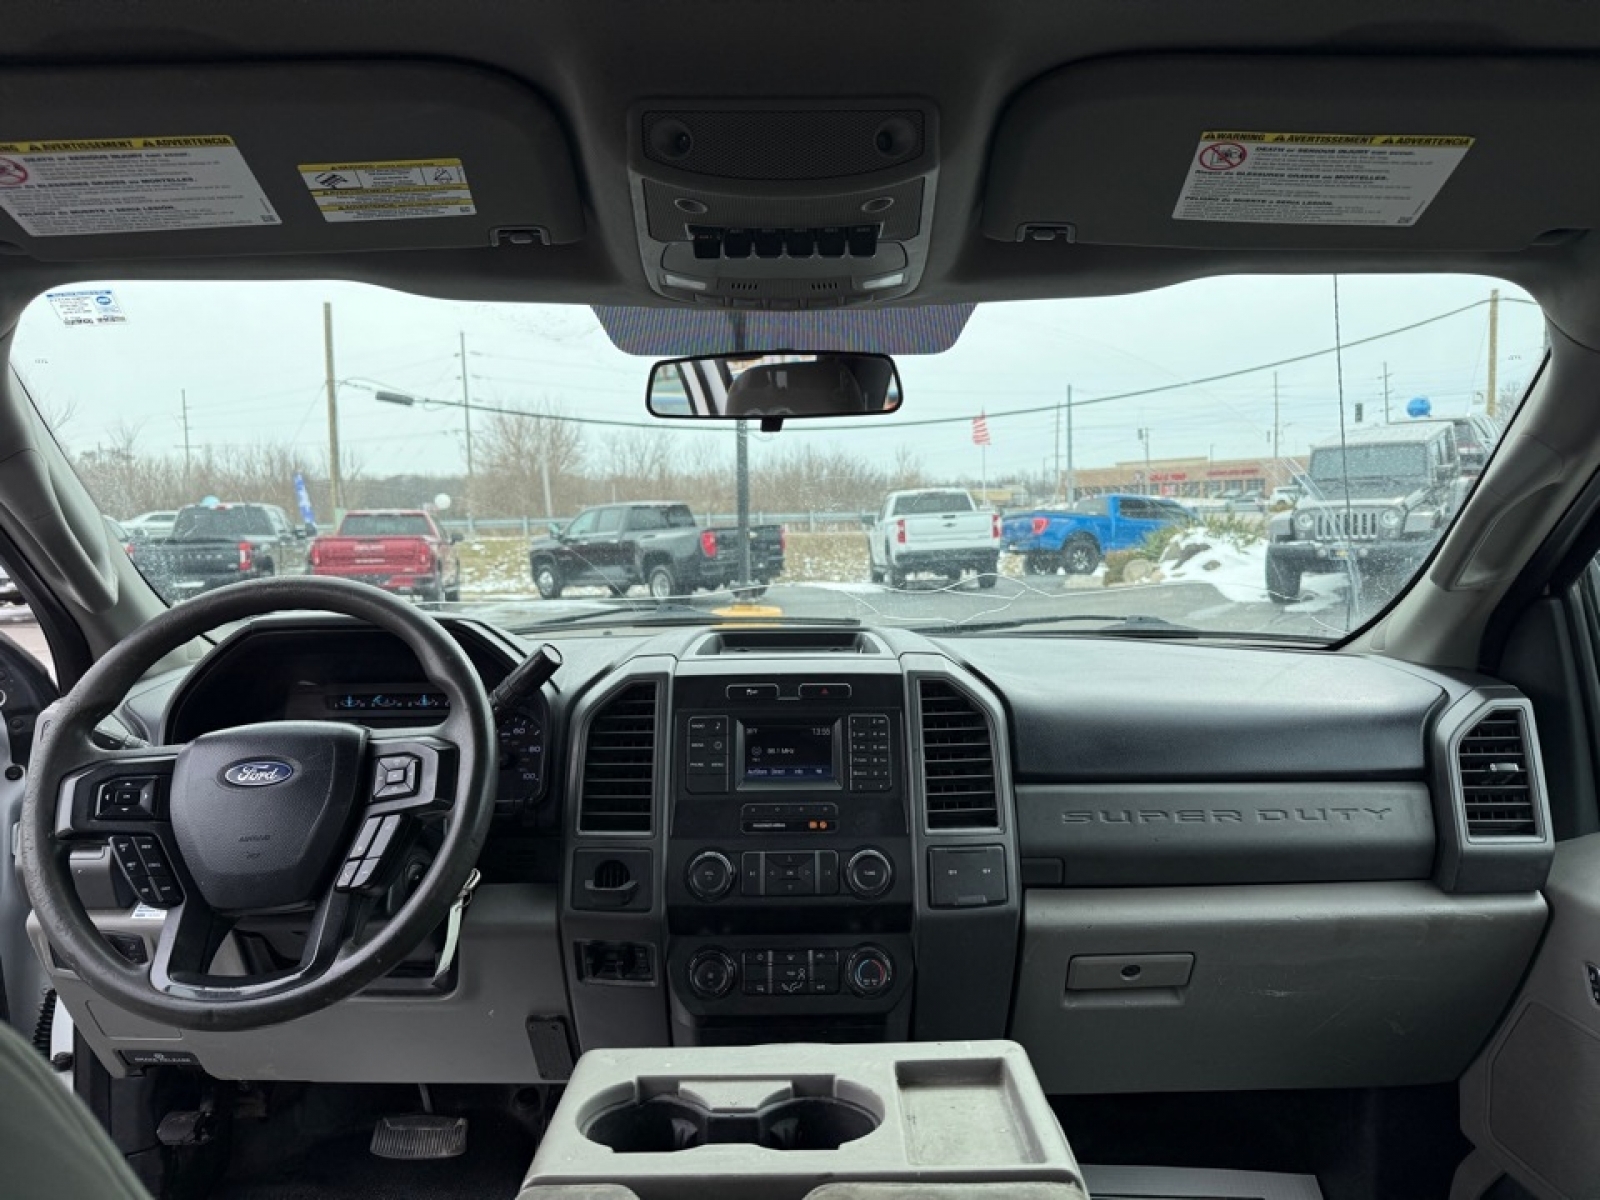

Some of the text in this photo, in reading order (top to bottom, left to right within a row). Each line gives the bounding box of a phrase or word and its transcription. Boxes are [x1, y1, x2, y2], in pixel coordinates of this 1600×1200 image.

[155, 137, 231, 147] ADVERTENCIA
[1216, 132, 1265, 142] WARNING
[1288, 133, 1375, 144] AVERTISSEMENT
[1396, 136, 1471, 146] ADVERTENCIA
[237, 765, 279, 782] Ford
[1061, 807, 1393, 823] SUPER DUTY
